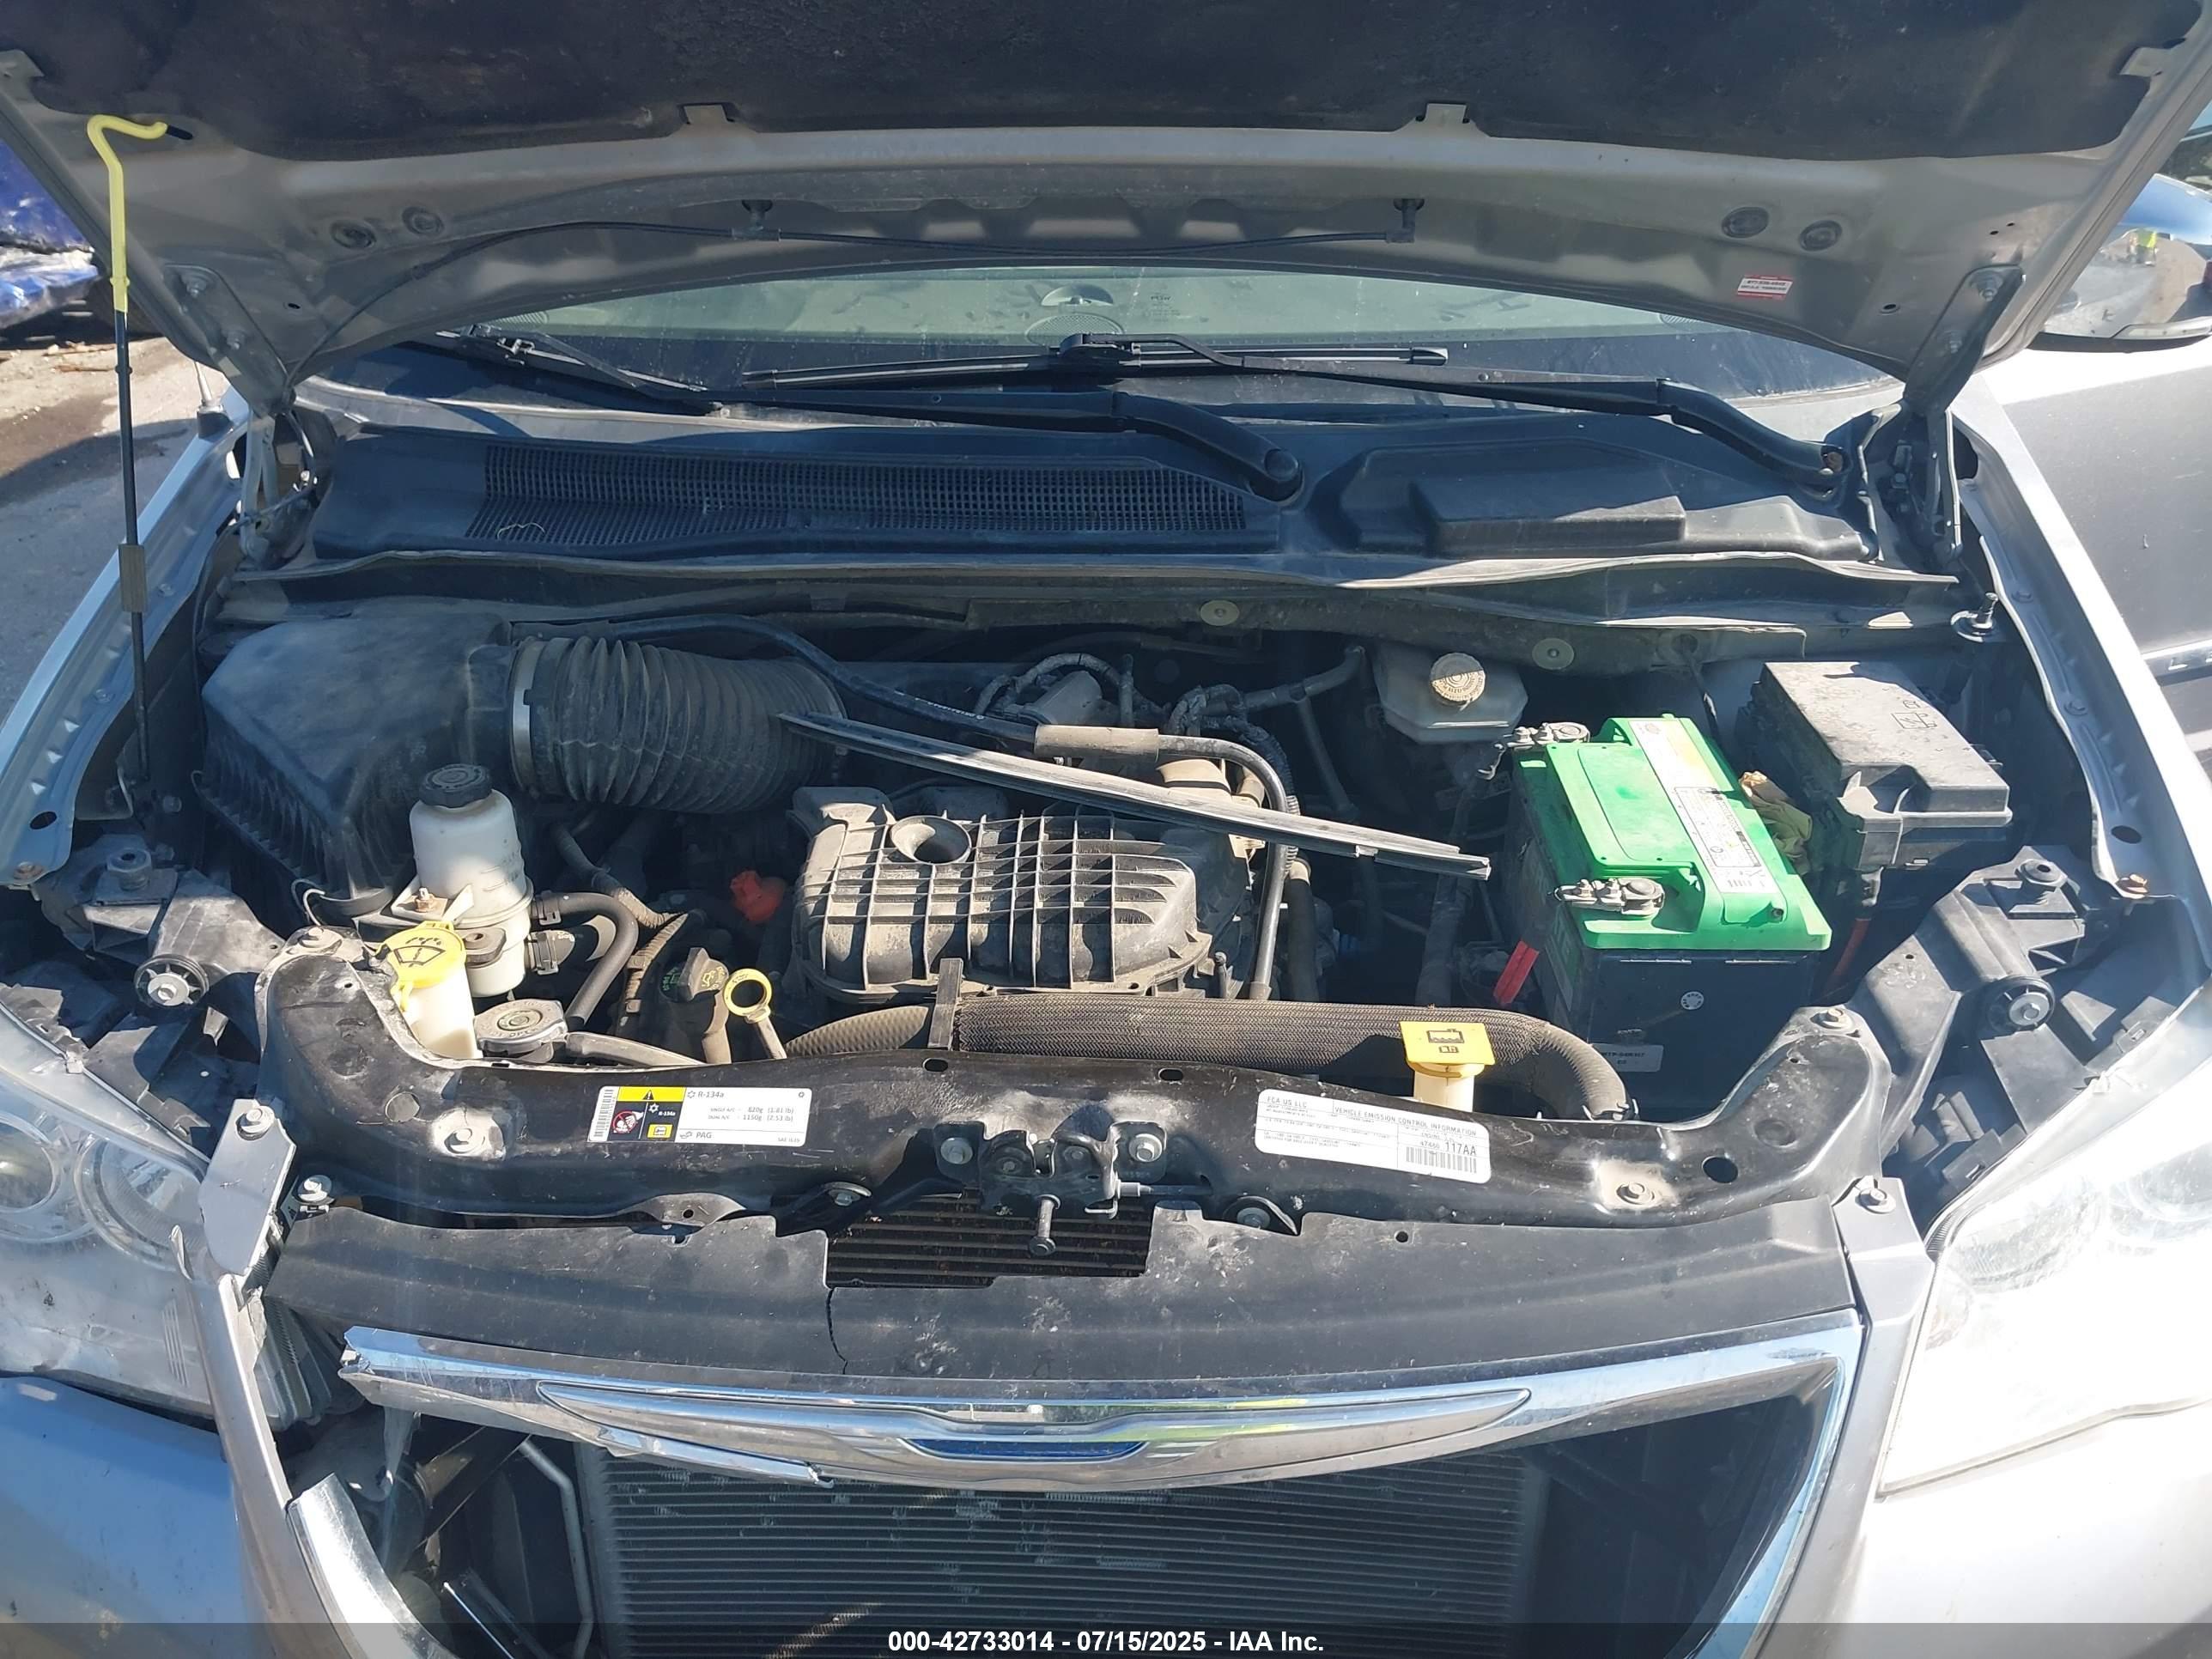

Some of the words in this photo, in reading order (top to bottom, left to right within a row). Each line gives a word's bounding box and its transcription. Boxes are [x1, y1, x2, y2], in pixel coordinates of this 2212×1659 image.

[1294, 1100, 1308, 1109] LLC
[1334, 1106, 1362, 1117] VEHICLE
[1364, 1111, 1396, 1123] EMISSION
[1398, 1116, 1429, 1128] CONTROL
[1431, 1122, 1477, 1136] INFORMATION
[1445, 1141, 1477, 1158] 117AA
